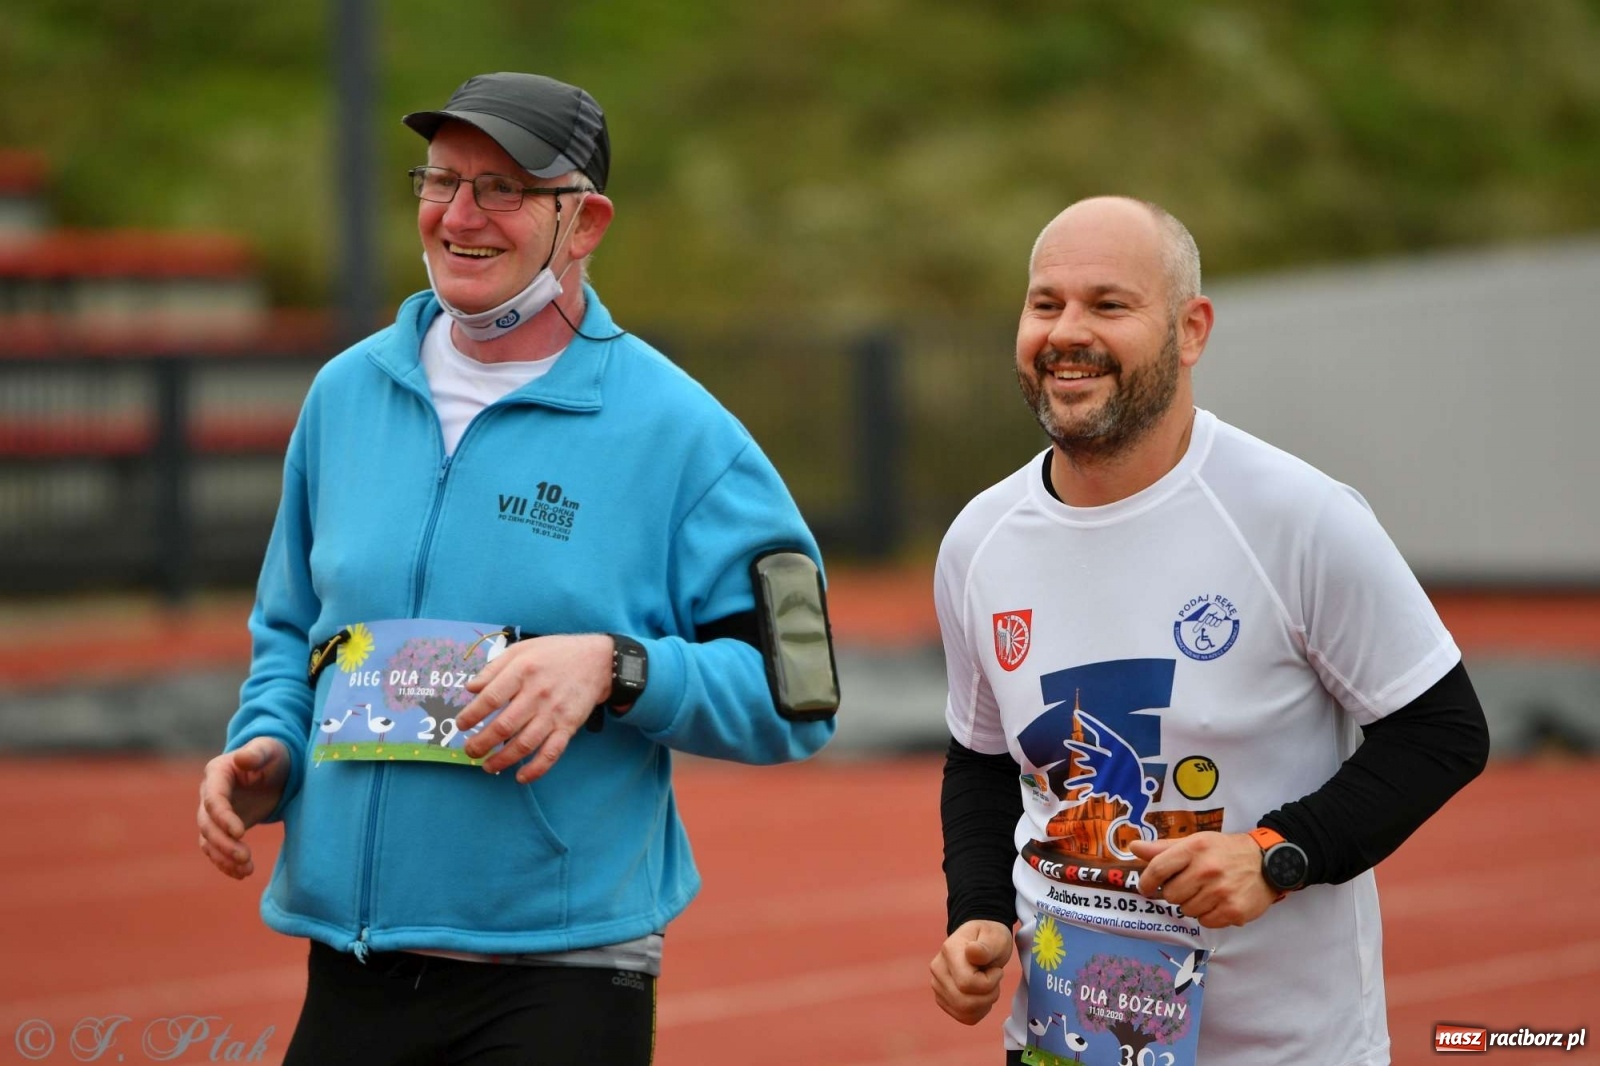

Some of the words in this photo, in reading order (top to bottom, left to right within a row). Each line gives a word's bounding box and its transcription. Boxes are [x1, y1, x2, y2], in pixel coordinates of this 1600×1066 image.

[536, 481, 562, 504] 10
[562, 497, 580, 510] km
[498, 494, 528, 516] VII
[530, 508, 574, 528] CROSS
[533, 501, 575, 517] EKO-OKNA
[532, 527, 570, 541] 19.01.2019
[1178, 594, 1209, 618] PODAJ
[349, 670, 381, 687] BIEG
[389, 670, 419, 686] DLA
[398, 687, 436, 697] 11.10.2020
[1046, 885, 1091, 908] Racibórz
[1046, 973, 1073, 997] BIEG
[1080, 984, 1108, 1006] DLA
[1118, 993, 1188, 1020] BOŻENY
[1088, 1005, 1124, 1021] 11.10.2020
